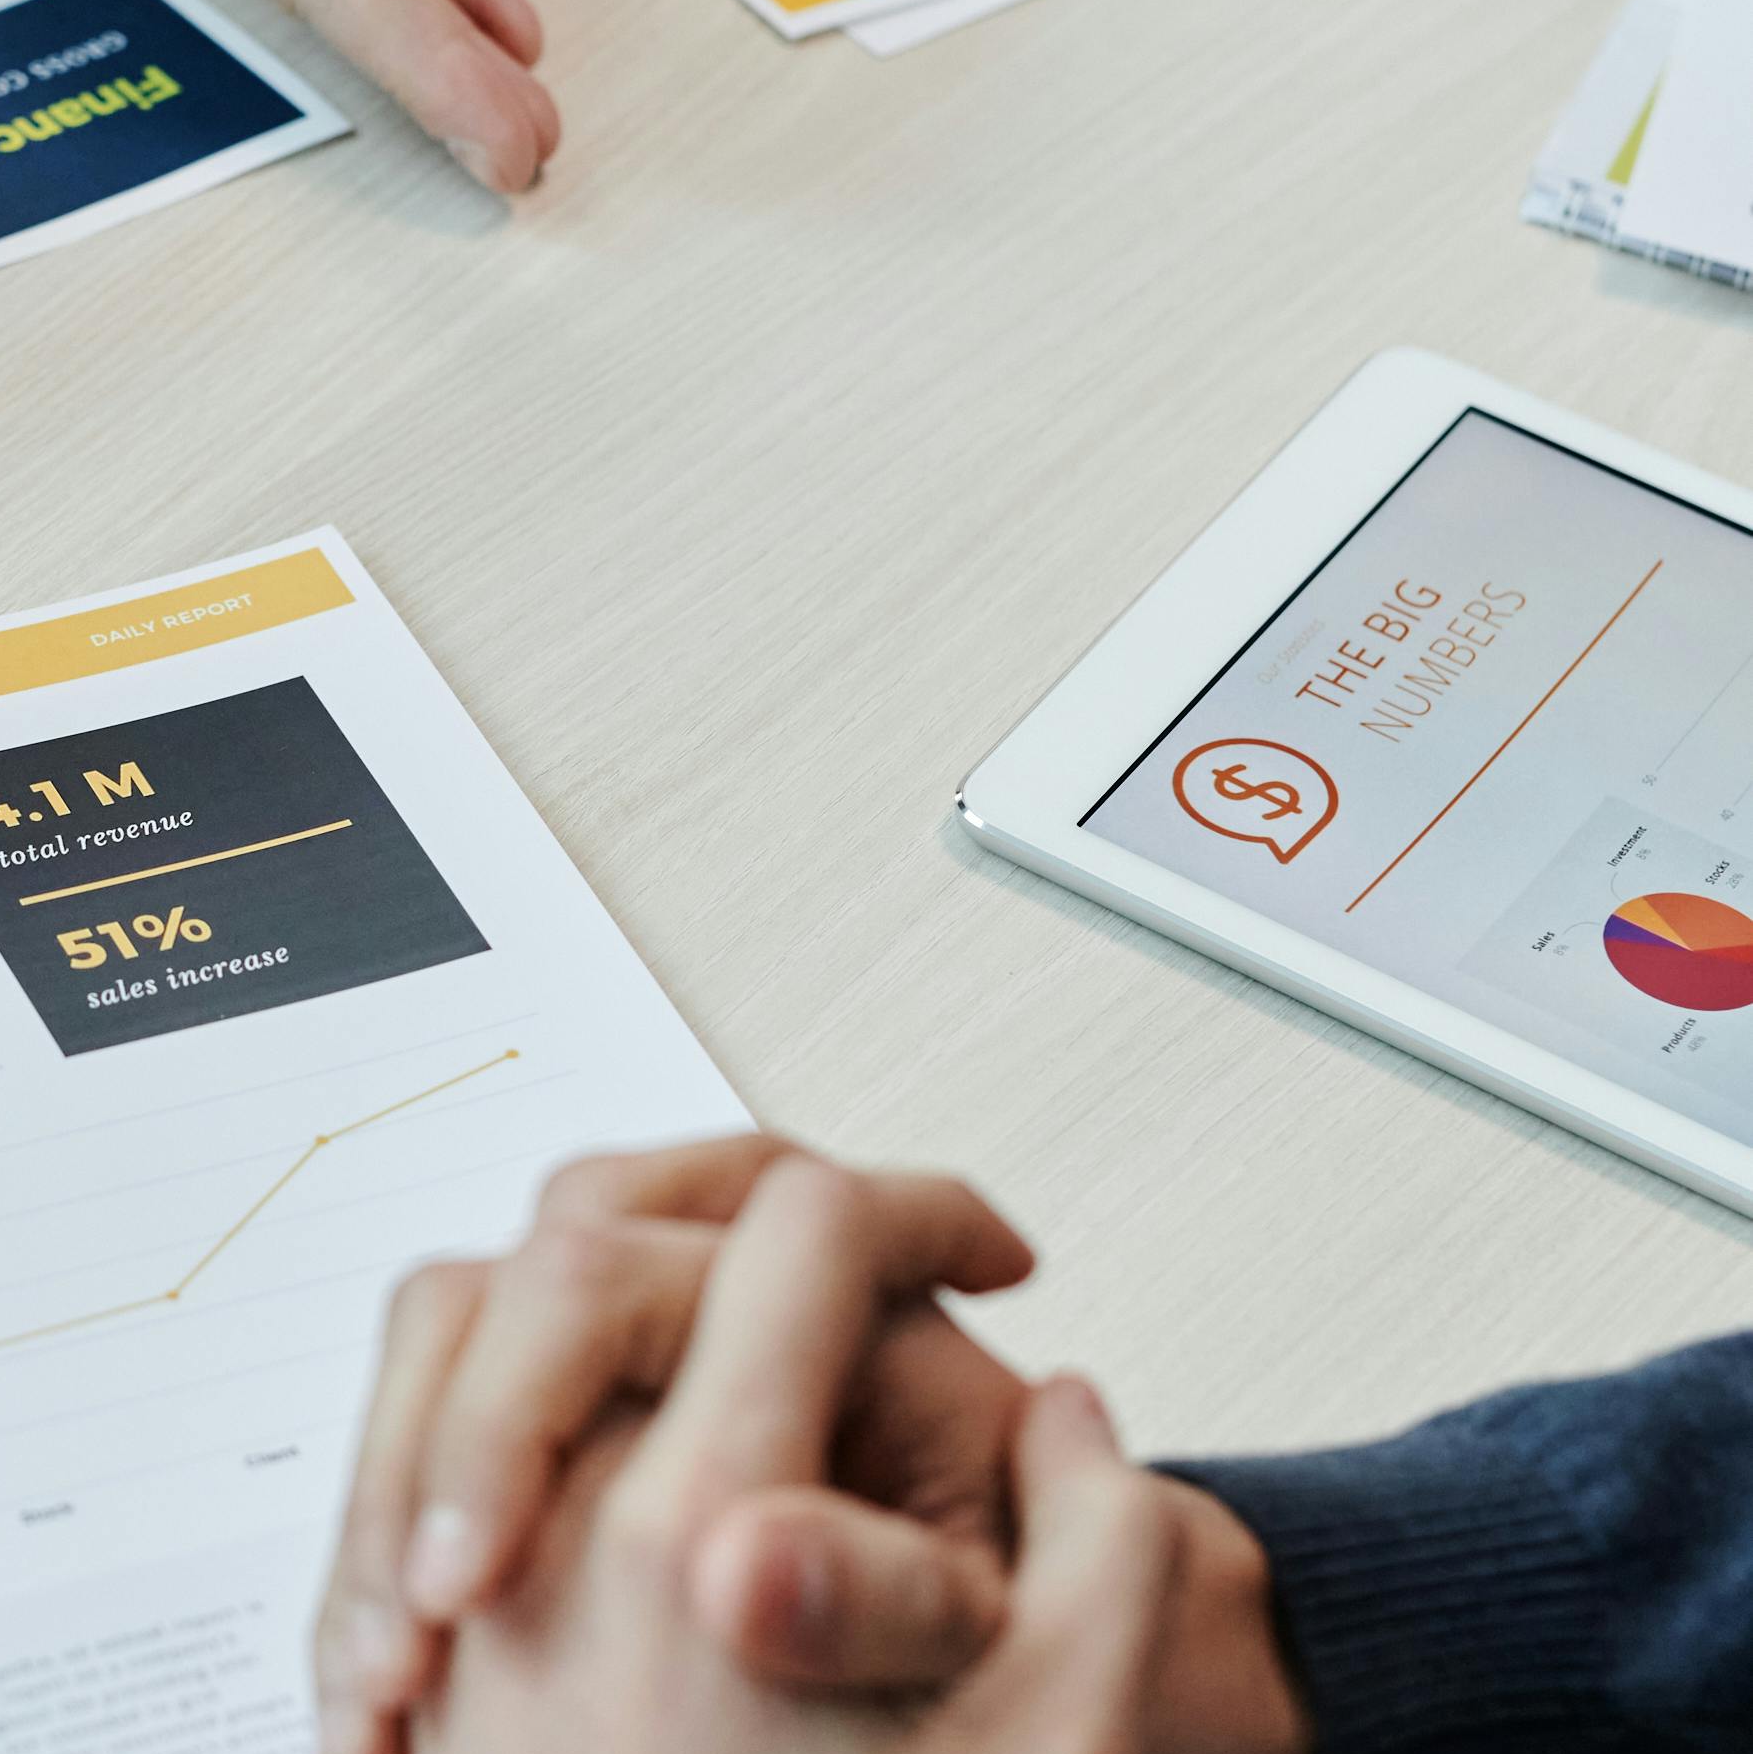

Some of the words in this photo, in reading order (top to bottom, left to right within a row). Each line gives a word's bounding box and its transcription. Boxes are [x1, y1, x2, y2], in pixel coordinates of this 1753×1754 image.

[28, 32, 126, 79] GROSS
[89, 619, 154, 646] DAILY
[161, 593, 251, 628] REPORT
[1294, 640, 1385, 707] THE
[1362, 579, 1441, 642] BIG
[1358, 581, 1526, 743] NUMBERS
[82, 761, 155, 806] M
[76, 811, 193, 849] revenue
[1607, 826, 1646, 866] Investment
[1704, 860, 1730, 884] Stocks
[56, 905, 212, 969] 51%
[1531, 931, 1554, 951] Sales
[86, 978, 157, 1008] sales
[165, 947, 289, 989] increase
[1661, 1018, 1696, 1053] Products
